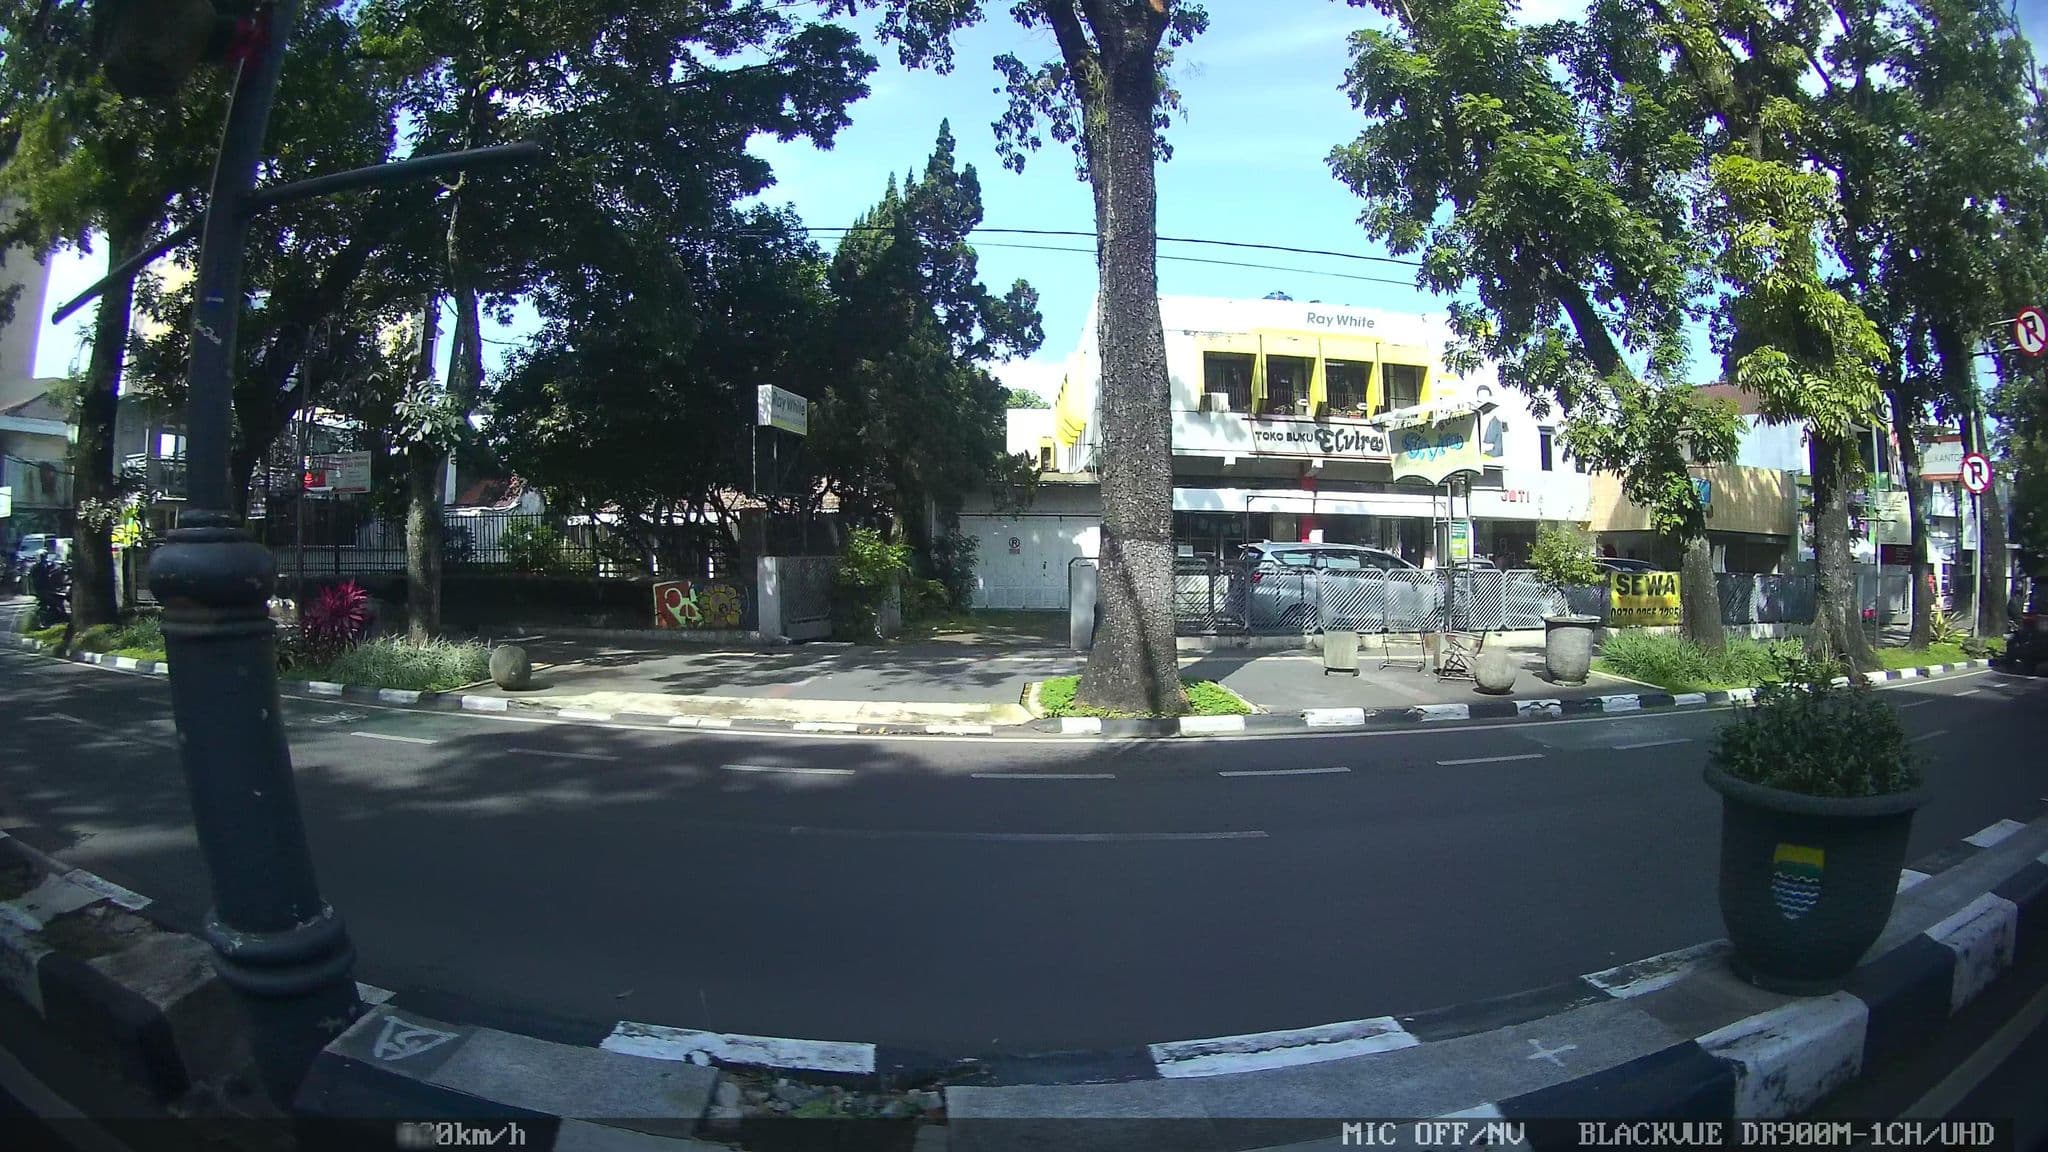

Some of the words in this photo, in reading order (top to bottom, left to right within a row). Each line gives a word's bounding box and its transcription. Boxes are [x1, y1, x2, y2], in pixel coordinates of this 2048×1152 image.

[1306, 312, 1334, 327] Ray
[1336, 314, 1375, 329] White
[1255, 431, 1284, 442] TOKO
[1286, 431, 1314, 443] BUKU
[1314, 428, 1384, 453] Elvira
[1615, 573, 1676, 596] SEWA
